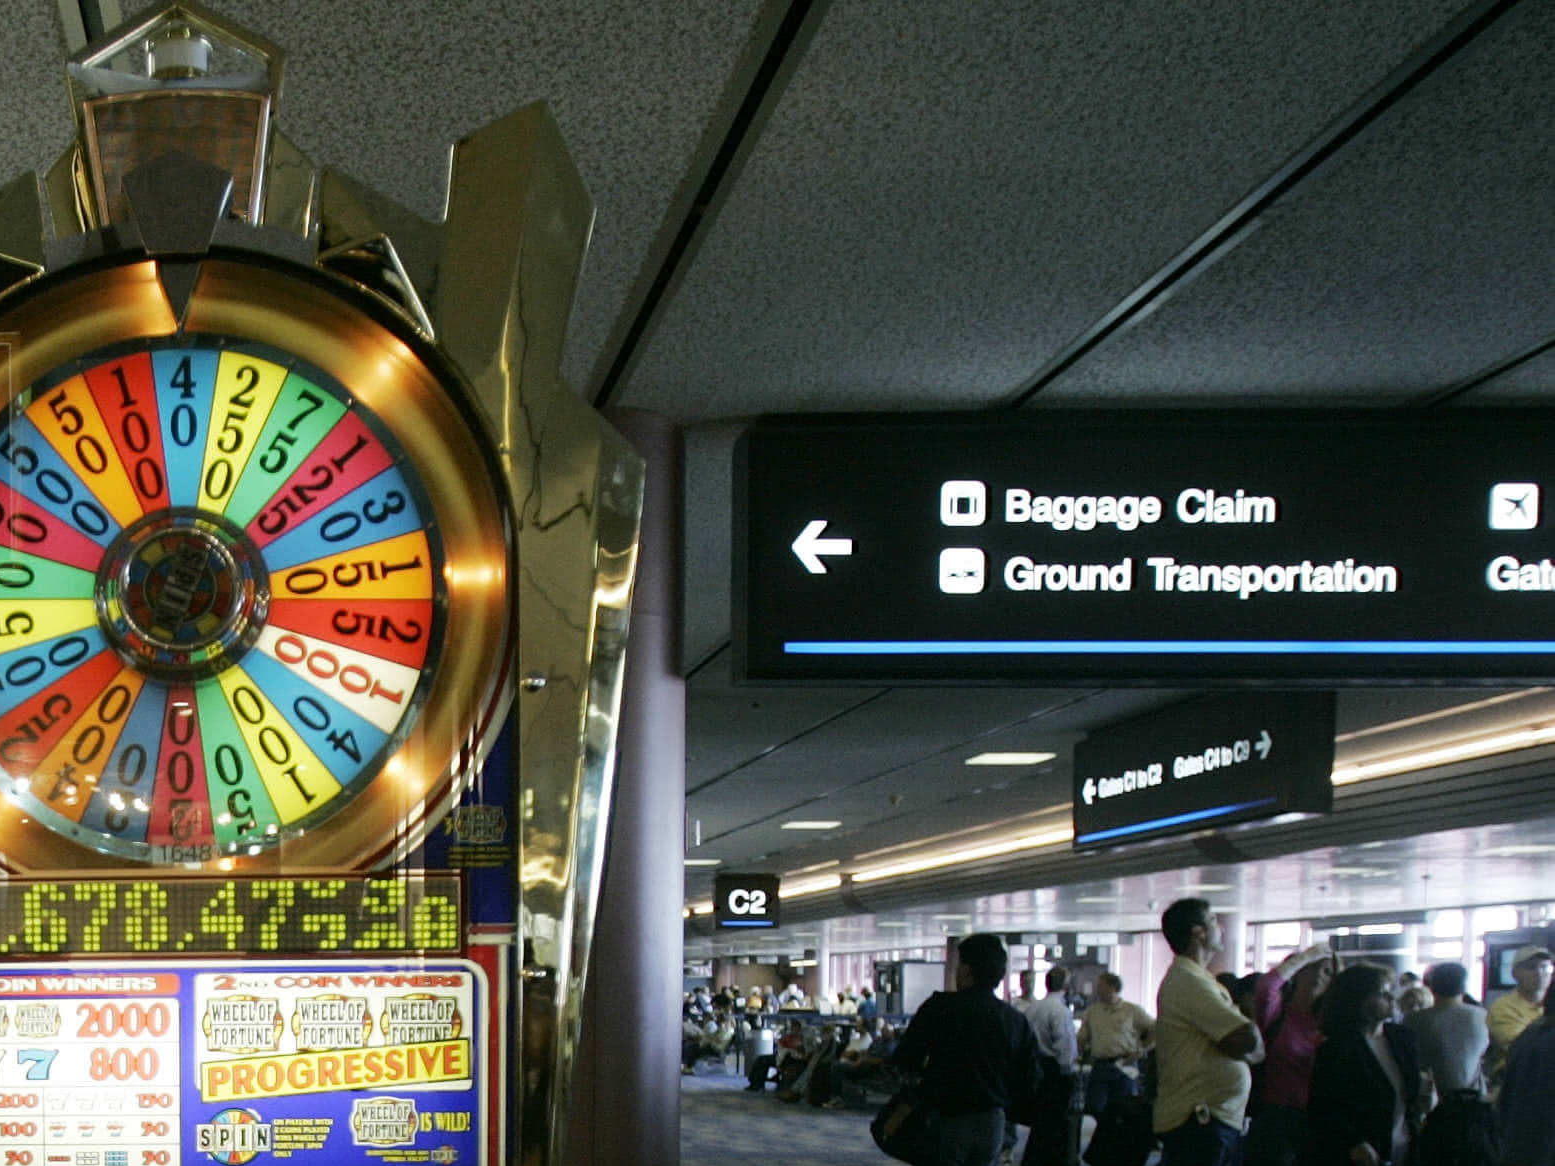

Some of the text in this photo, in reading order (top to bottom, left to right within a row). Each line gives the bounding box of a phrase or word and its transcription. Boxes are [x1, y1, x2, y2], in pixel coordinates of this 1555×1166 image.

[169, 357, 198, 447] 40
[48, 391, 109, 475] 50
[111, 367, 163, 500] 100
[205, 365, 261, 499] 250
[259, 391, 324, 471] 75
[257, 437, 370, 535] 125
[1004, 488, 1276, 531] Baggage Claim
[285, 556, 423, 596] 150
[1004, 557, 1398, 598] Ground Transportation
[1486, 556, 1555, 592] Gat
[274, 633, 404, 705] 1000
[729, 891, 767, 915] C2
[40, 975, 157, 992] WINNERS
[274, 976, 342, 989] COIN
[76, 1003, 171, 1038] 2000
[258, 1002, 274, 1021] OF
[90, 1047, 161, 1081] 800
[207, 1043, 462, 1098] PROGRESSIVE
[201, 1128, 269, 1148] SPIN
